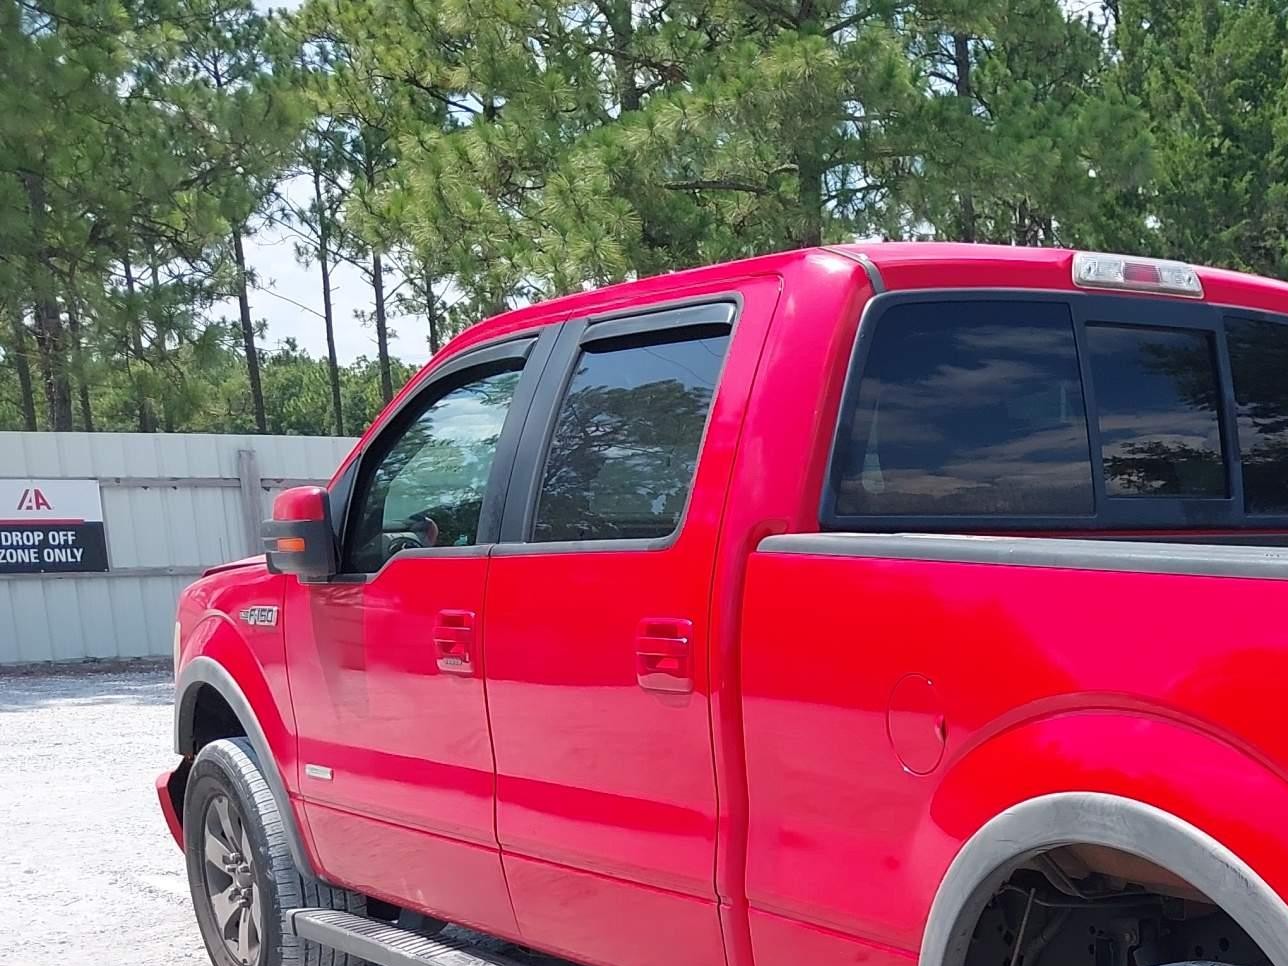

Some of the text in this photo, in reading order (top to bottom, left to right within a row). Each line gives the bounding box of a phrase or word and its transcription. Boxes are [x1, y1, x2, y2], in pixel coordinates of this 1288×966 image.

[1, 531, 76, 546] DROP OFF
[43, 548, 84, 562] ONLY
